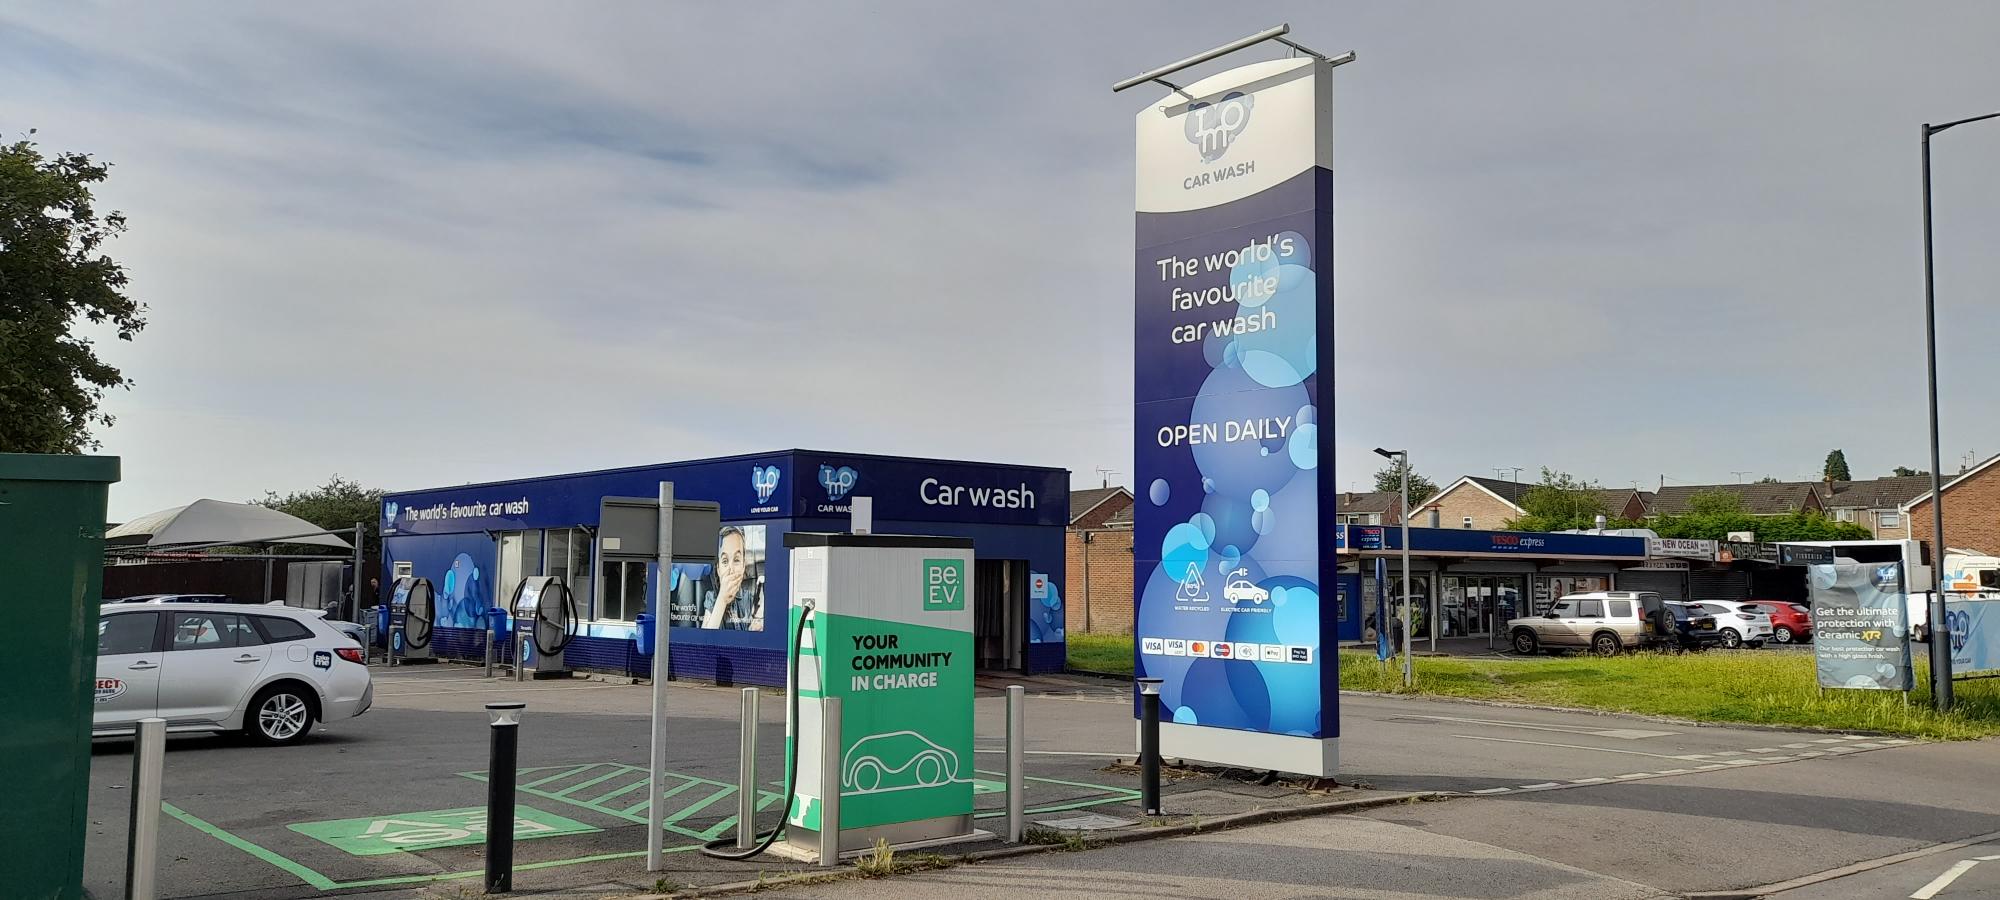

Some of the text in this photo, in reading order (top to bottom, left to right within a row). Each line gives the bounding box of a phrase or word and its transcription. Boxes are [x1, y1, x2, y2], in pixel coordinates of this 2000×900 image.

[1183, 161, 1255, 190] CAR WASH
[1157, 233, 1294, 281] The world's
[1171, 274, 1277, 312] favourite
[1171, 306, 1276, 344] car wash
[1158, 416, 1292, 447] OPEN DAILY
[920, 477, 1035, 509] Car wash
[405, 496, 529, 521] The world's favourite car wash
[835, 505, 851, 513] WAS
[1520, 537, 1545, 549] express
[1662, 540, 1676, 549] NEW
[1678, 540, 1699, 550] OCEAN
[929, 586, 957, 603] EV
[1816, 607, 1898, 616] Get the ultimate
[1817, 619, 1895, 629] protection with
[852, 634, 898, 650] YOUR
[1818, 631, 1881, 641] Ceramic XTR
[1145, 641, 1162, 650] VISA
[852, 652, 952, 670] COMMUNITY
[851, 672, 937, 691] IN CHARGE
